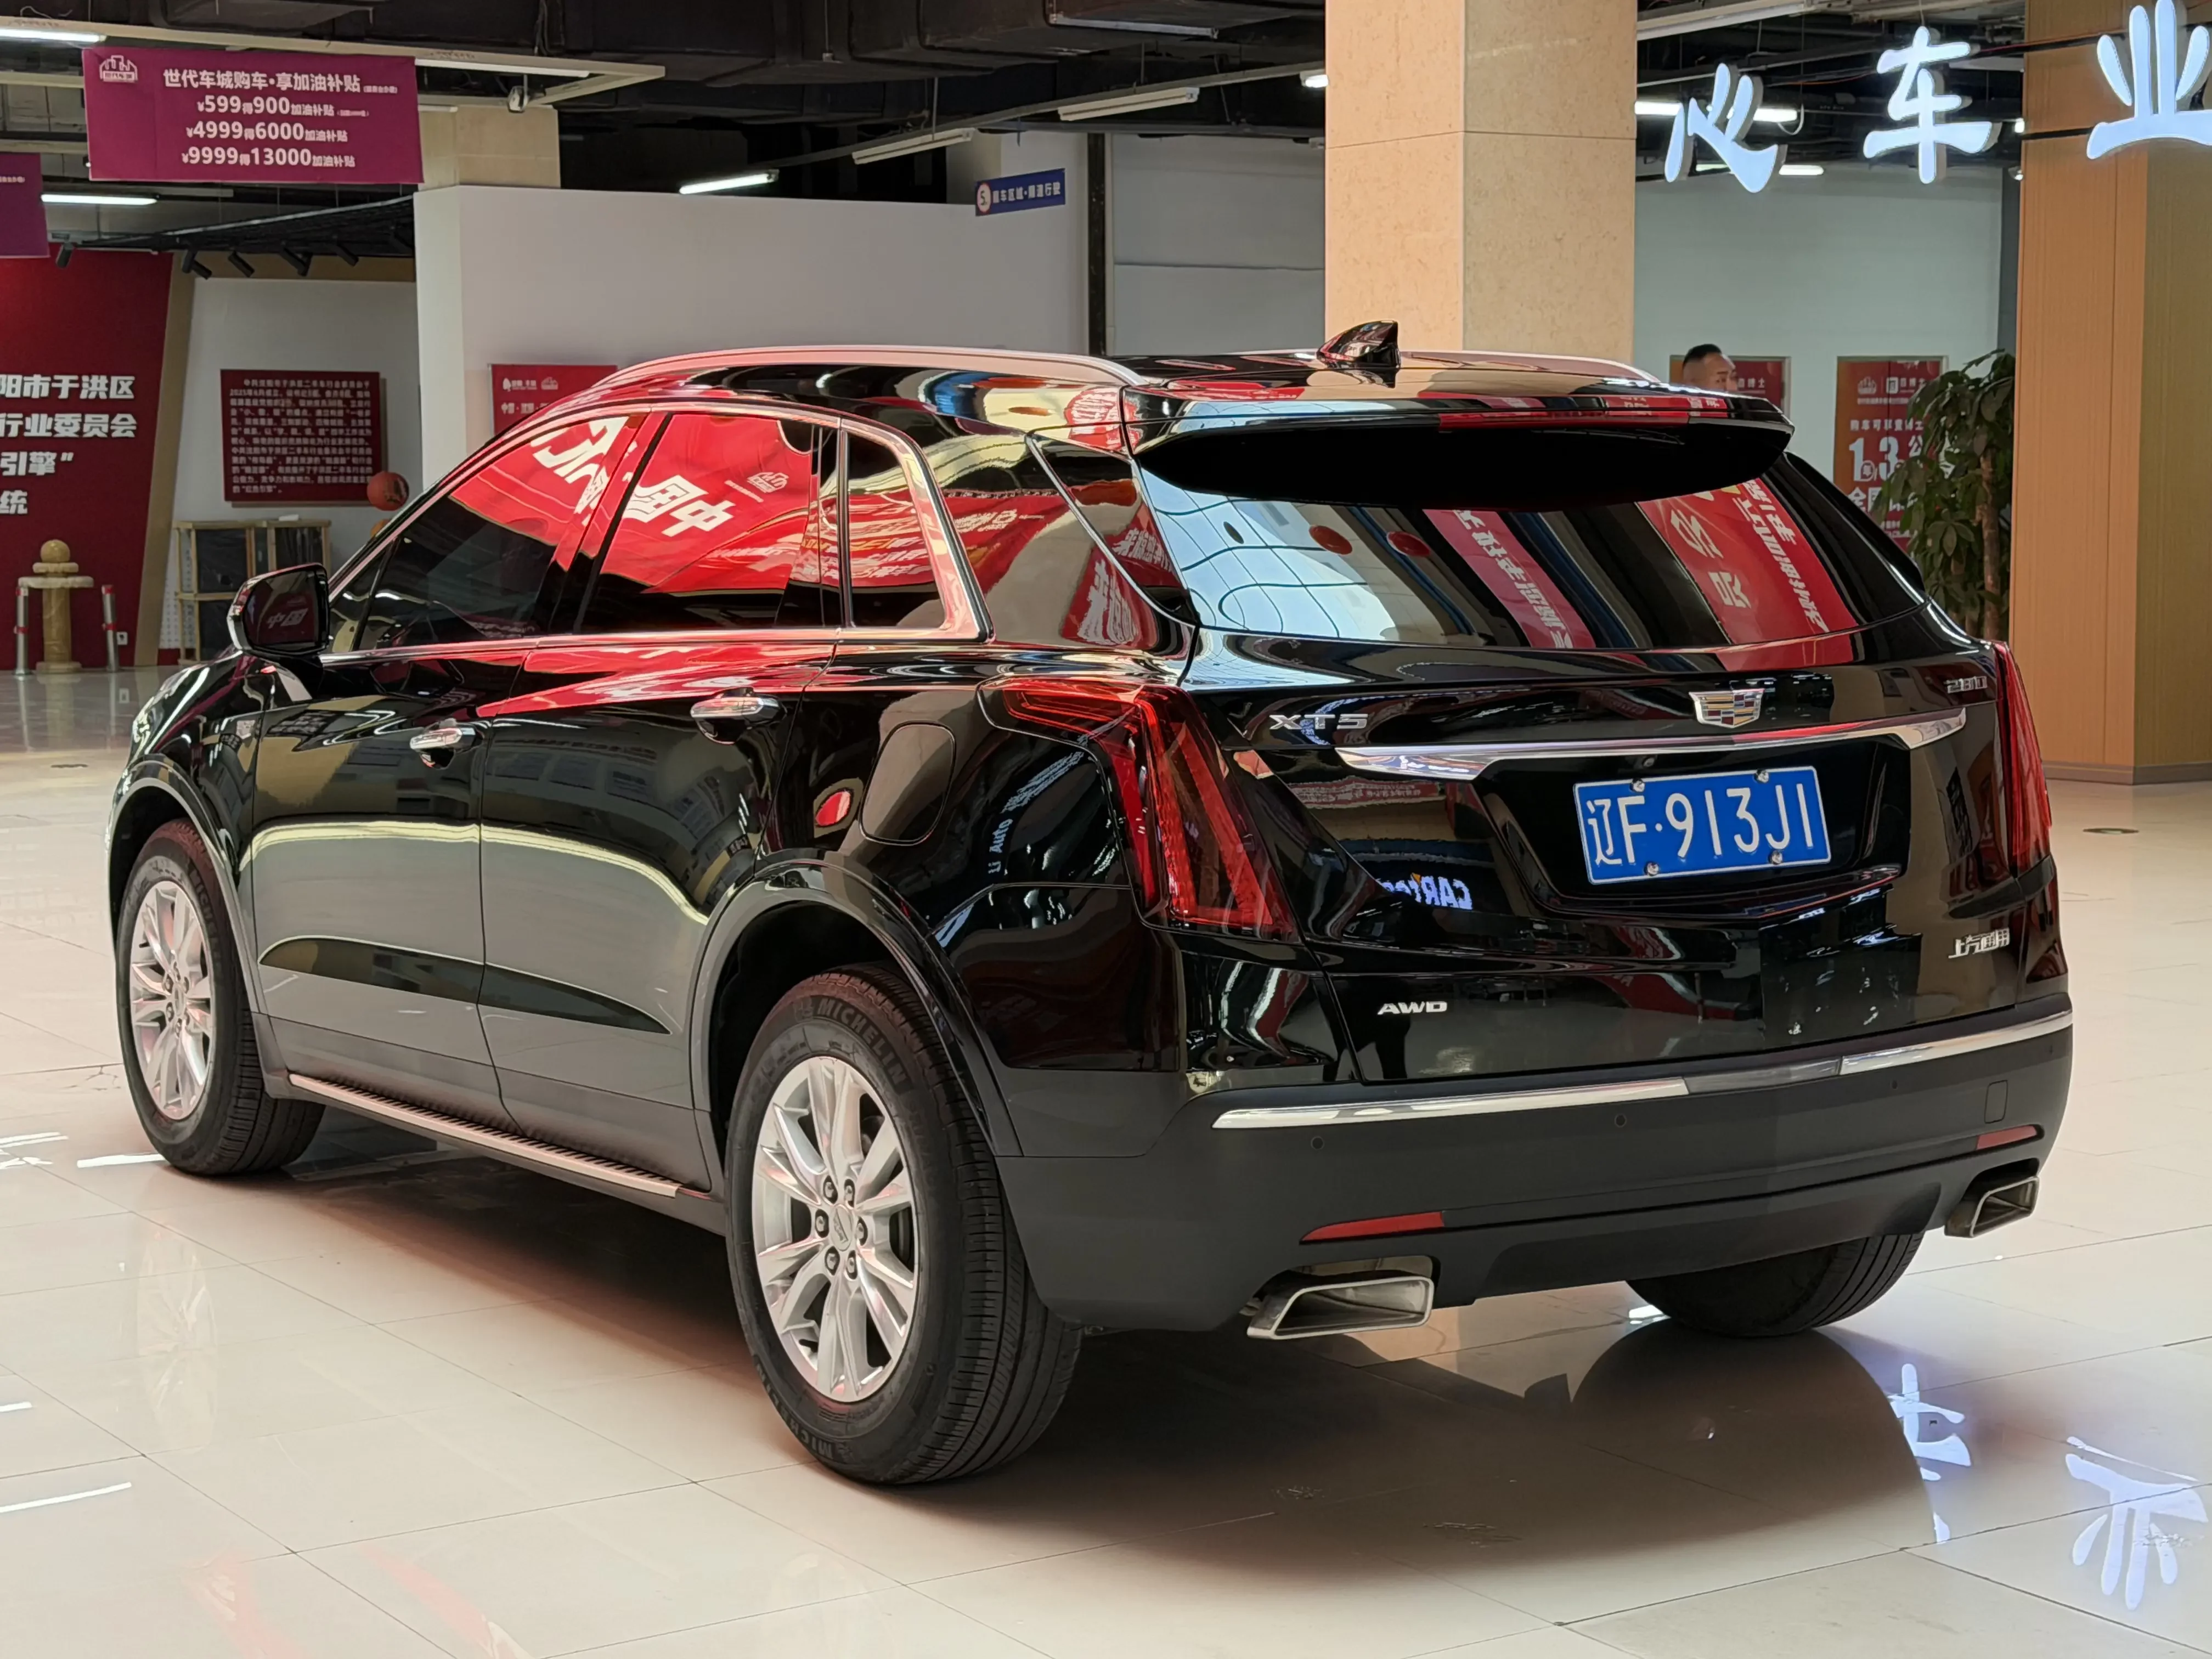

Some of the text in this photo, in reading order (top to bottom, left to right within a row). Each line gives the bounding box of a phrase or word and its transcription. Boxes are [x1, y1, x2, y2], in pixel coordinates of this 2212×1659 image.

[163, 69, 361, 93] 世代车城购车·享加油补贴
[1269, 714, 1369, 730] XT5
[1948, 927, 2010, 959] 上汽通用
[1377, 1001, 1448, 1015] AWD
[817, 997, 907, 1086] MICHELIN
